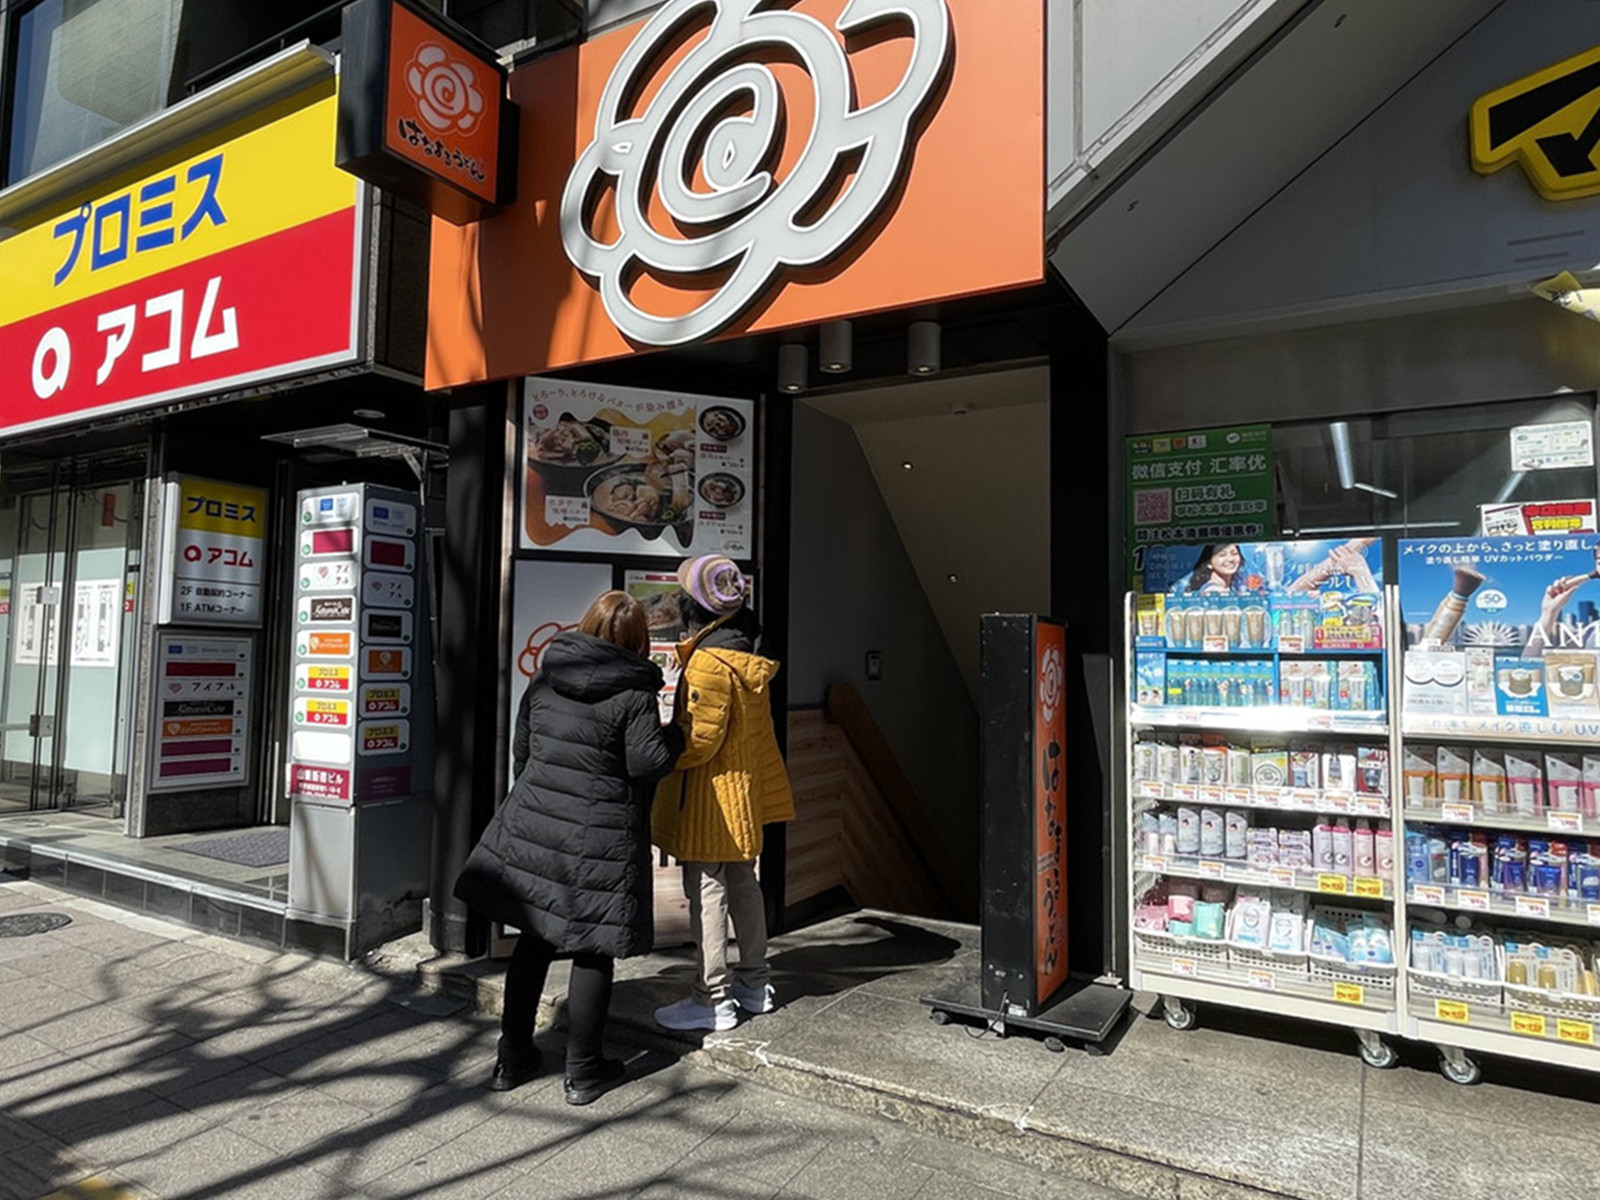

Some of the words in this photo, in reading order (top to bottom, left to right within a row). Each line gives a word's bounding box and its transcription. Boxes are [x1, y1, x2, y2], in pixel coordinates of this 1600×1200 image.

[52, 152, 228, 288] プロミス
[96, 275, 240, 387] アコム
[1132, 459, 1203, 480] 微信支付
[186, 495, 257, 523] プロミス
[207, 547, 254, 568] アコム
[1484, 553, 1564, 563] UVカットパウダー
[180, 586, 193, 596] 2F
[180, 602, 192, 612] 1F
[194, 603, 244, 614] ATMコーナー
[1526, 620, 1600, 649] AN
